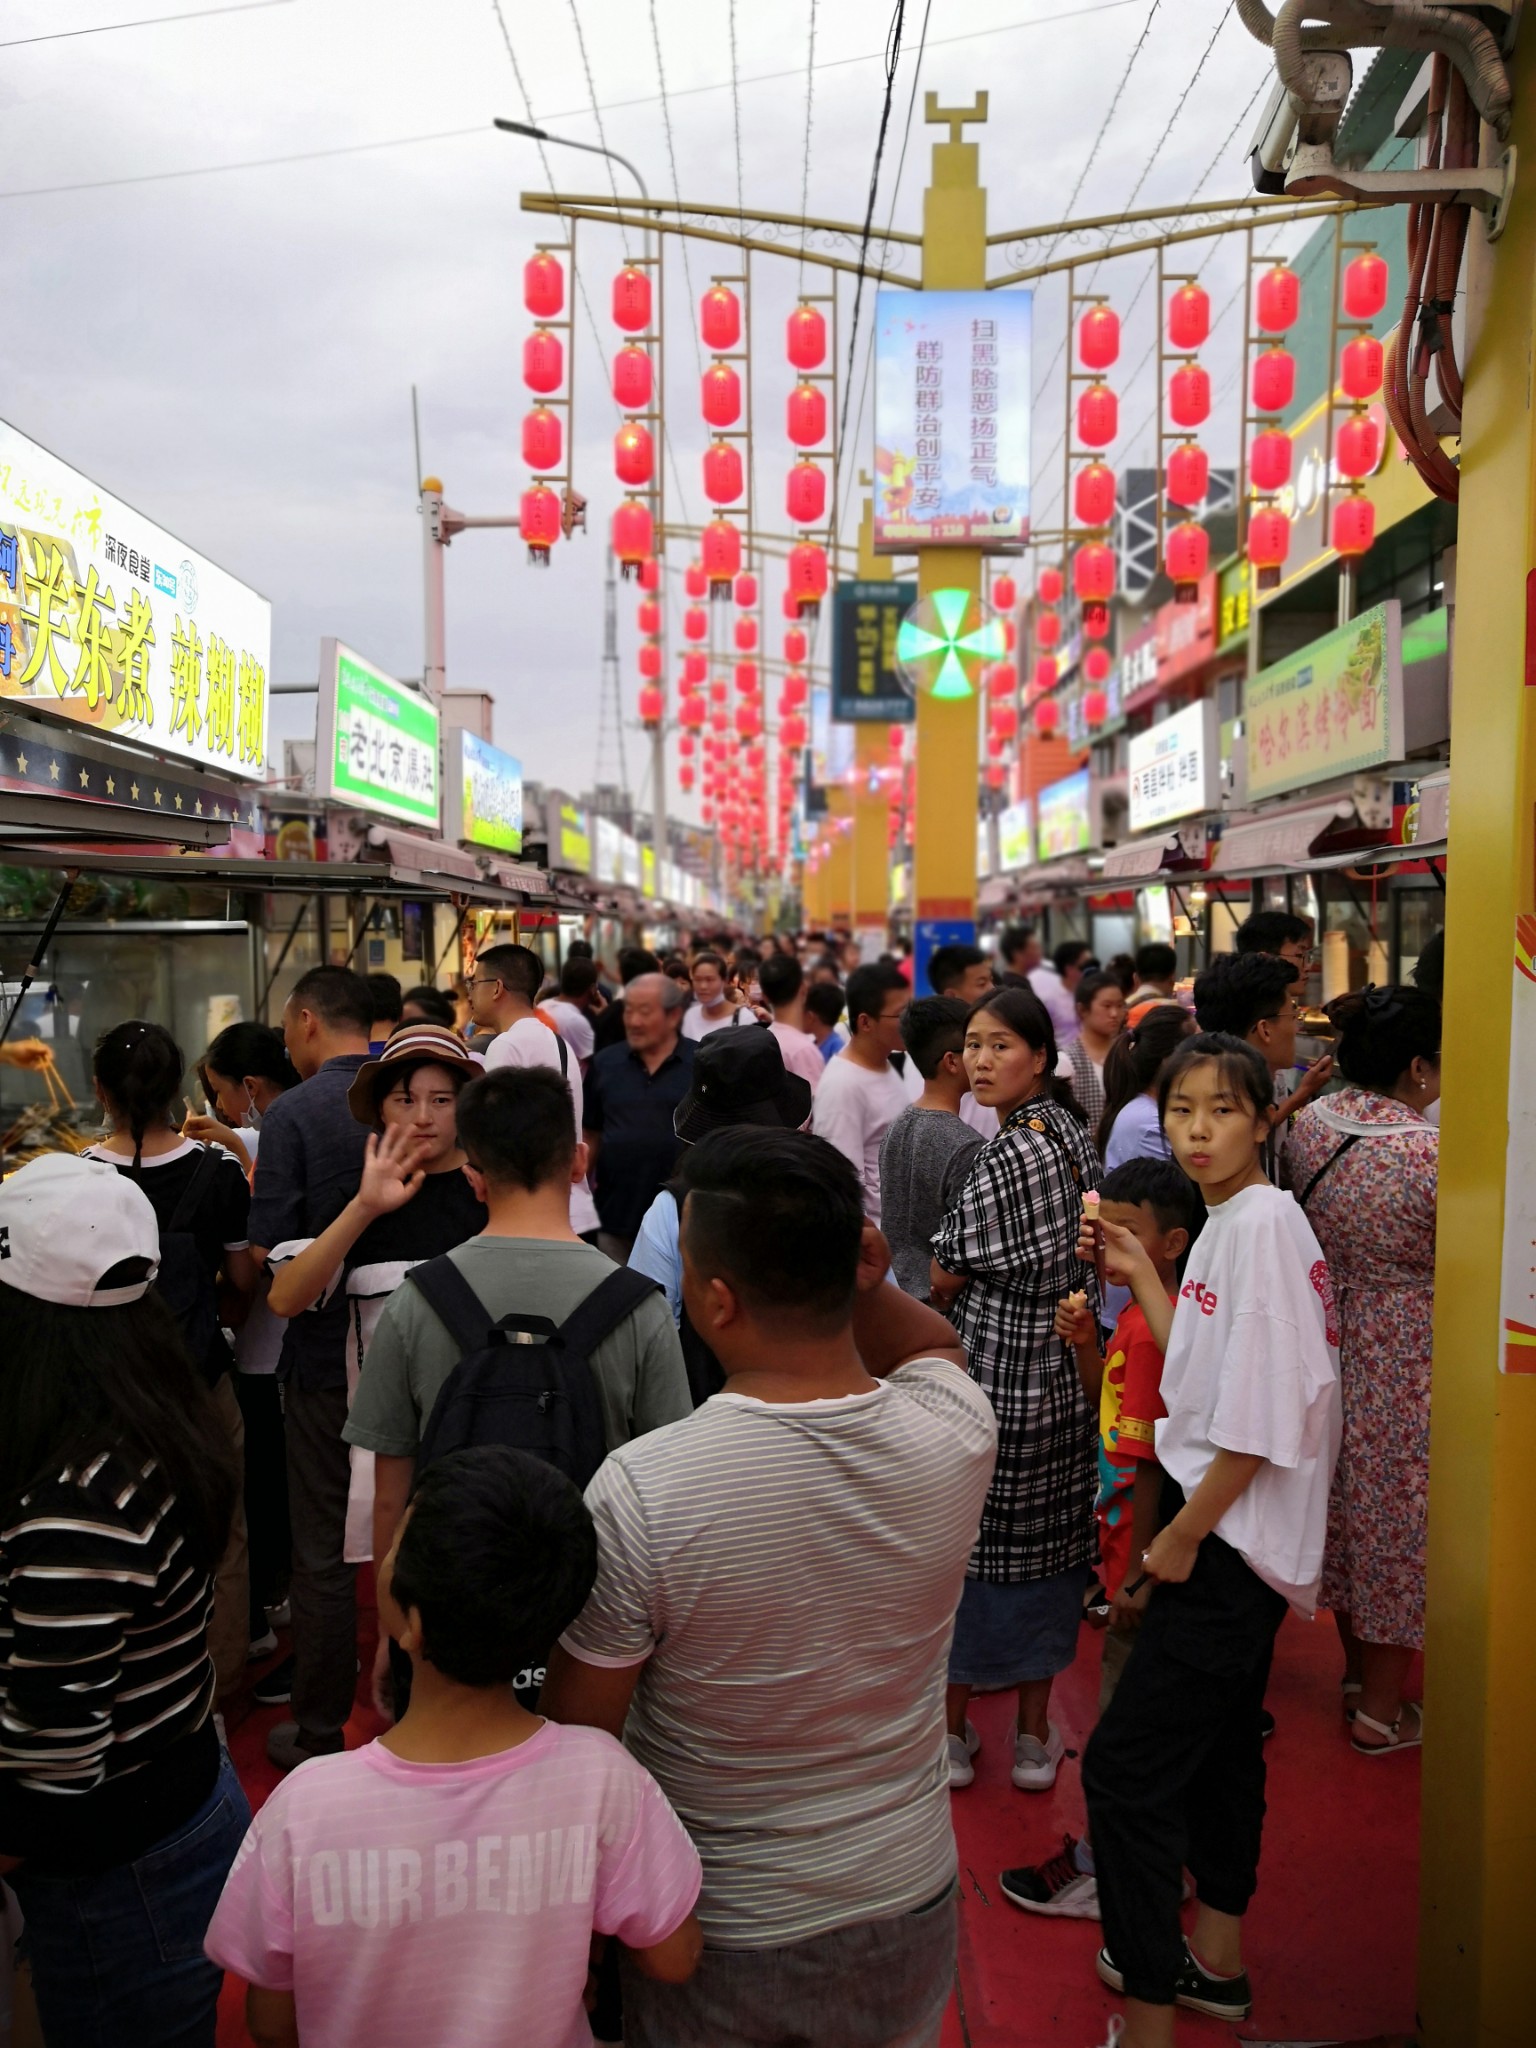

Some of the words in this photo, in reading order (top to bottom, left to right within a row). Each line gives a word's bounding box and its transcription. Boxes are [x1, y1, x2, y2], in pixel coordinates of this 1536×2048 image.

[914, 340, 941, 508] 群防群治创平安
[970, 318, 996, 487] 扫黑除恶扬正气
[105, 533, 151, 584] 深夜食堂
[19, 537, 156, 727] 关东煮
[169, 613, 266, 767] 辣糊糊
[1258, 668, 1377, 767] 哈尔滨烤冷面
